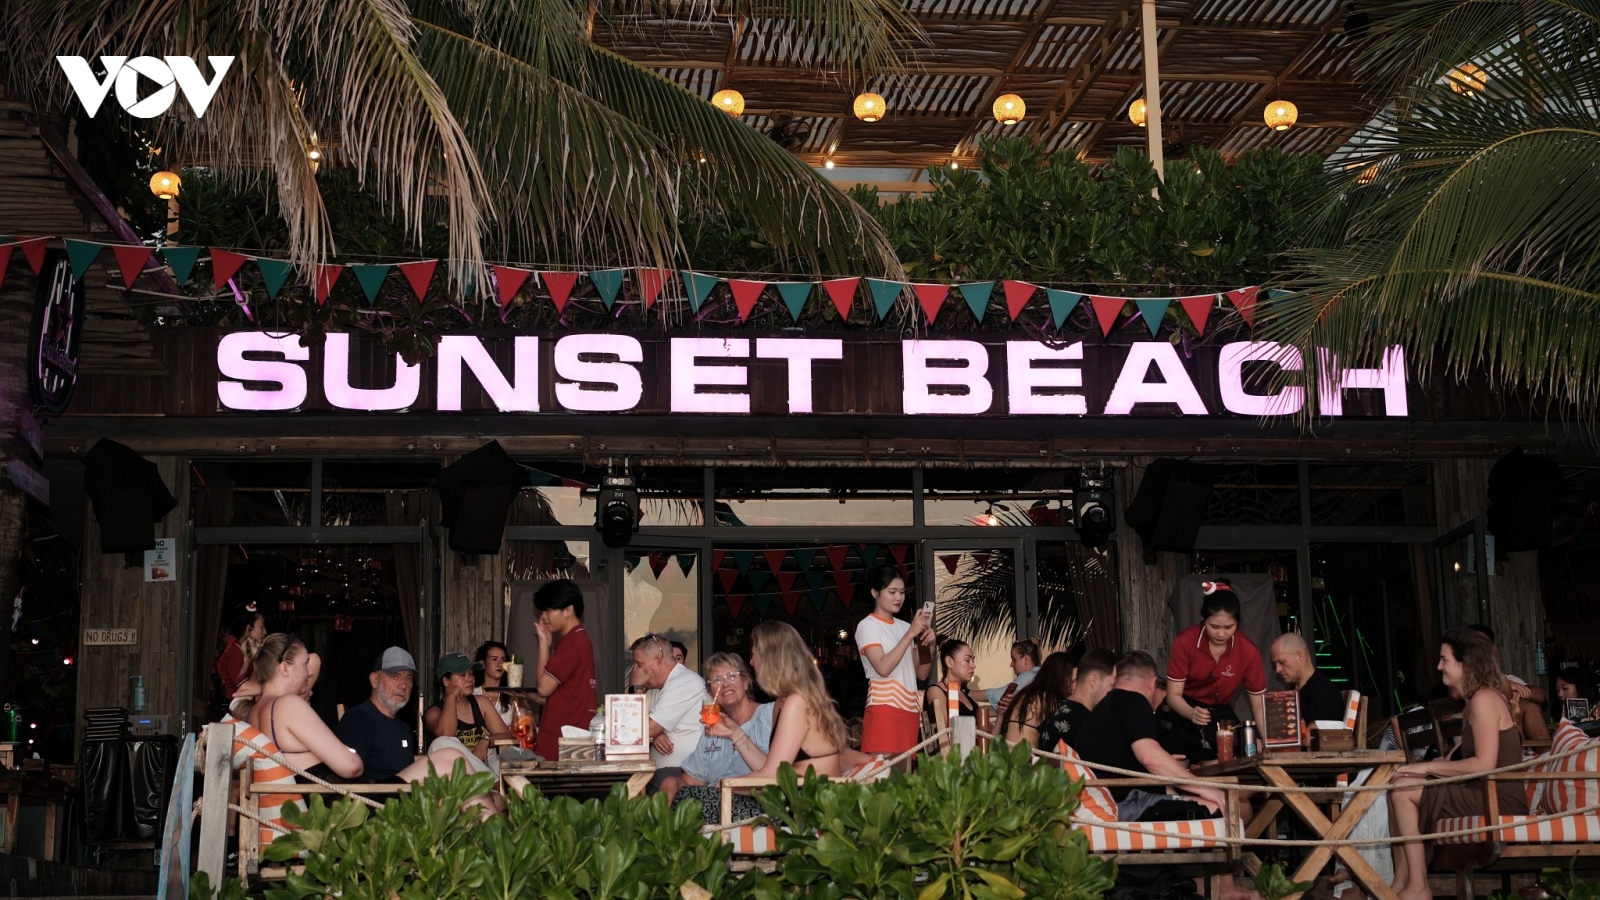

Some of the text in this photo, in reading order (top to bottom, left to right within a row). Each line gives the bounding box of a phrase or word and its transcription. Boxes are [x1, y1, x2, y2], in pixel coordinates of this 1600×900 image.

[216, 332, 1409, 418] SUNSET BEACH
[86, 631, 99, 643] NO
[101, 631, 129, 643] DRUGS
